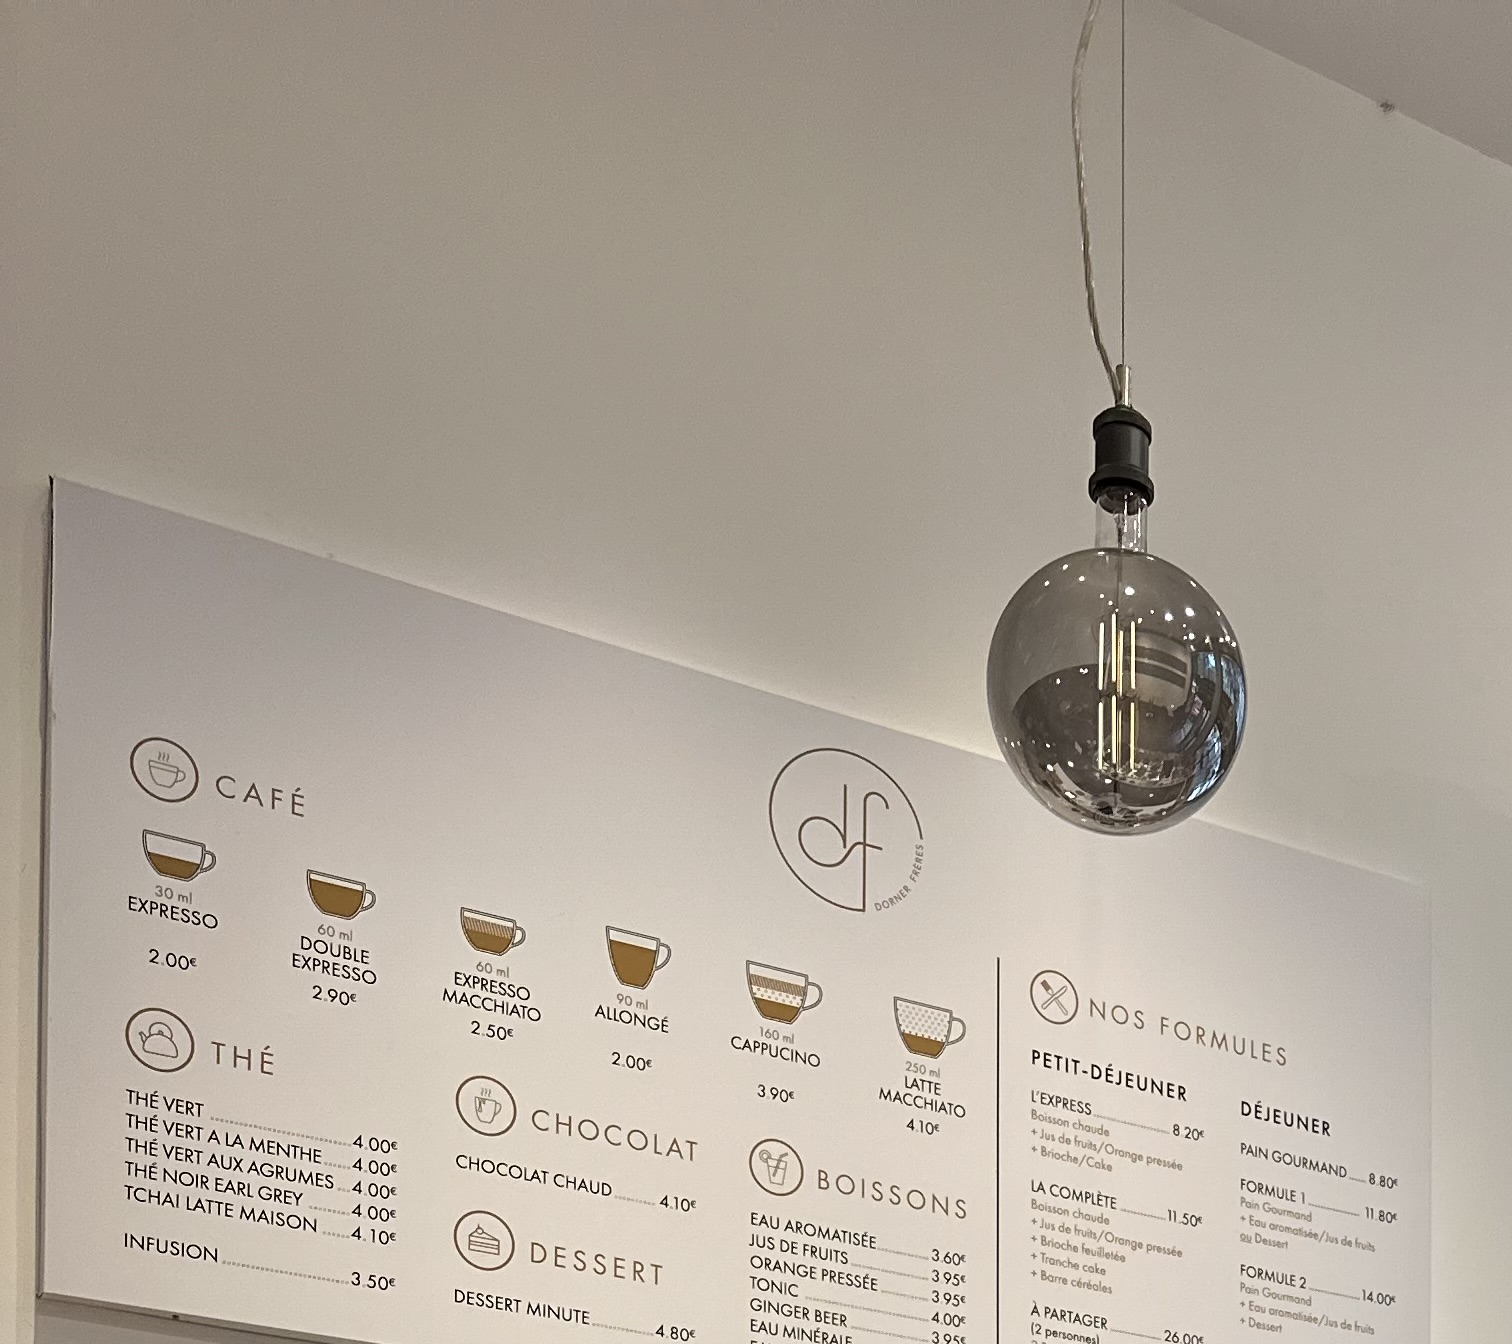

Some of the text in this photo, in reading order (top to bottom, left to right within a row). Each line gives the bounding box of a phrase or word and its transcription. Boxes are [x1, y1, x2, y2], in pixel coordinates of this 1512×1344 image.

[215, 775, 305, 817] CAFÉ
[154, 884, 193, 904] 30 ml
[874, 843, 925, 913] DORNER FRÈRES
[127, 896, 219, 930] EXPRESSO
[317, 922, 354, 942] 60 ml
[299, 935, 370, 966] DOUBLE
[291, 952, 378, 986] EXPRESSO
[475, 960, 510, 979] 60 ml
[453, 971, 531, 1001] EXPRESSO
[616, 993, 649, 1011] 90 ml
[442, 987, 542, 1022] MACCHIATO
[594, 1004, 670, 1034] ALLONGÉ
[758, 1026, 795, 1045] 160 ml
[1089, 998, 1288, 1067] NOS FORMULES
[211, 1041, 274, 1075] THÉ
[730, 1035, 821, 1068] CAPPUCINO
[905, 1060, 941, 1079] 250 ml
[1031, 1049, 1188, 1102] PETIT-DÉJEUNER
[904, 1075, 942, 1097] LATTE
[125, 1088, 159, 1110] THÉ
[163, 1096, 204, 1118] VERT
[878, 1087, 966, 1119] MACCHIATO
[1030, 1089, 1093, 1117] L'EXPRESS
[1240, 1100, 1331, 1137] DÉJEUNER
[125, 1112, 159, 1134] THÉ
[162, 1119, 204, 1142] VERT
[207, 1130, 221, 1146] A
[225, 1132, 245, 1150] LA
[249, 1137, 323, 1165] MENTHE
[531, 1109, 698, 1162] CHOCOLAT
[1030, 1108, 1110, 1138] Boisson chaude
[125, 1136, 159, 1158] THÉ
[162, 1143, 204, 1165] VERT
[207, 1152, 244, 1174] AUX
[247, 1161, 335, 1190] AGRUMES
[455, 1154, 550, 1185] CHOCOLAT
[553, 1173, 613, 1197] CHAUD
[1239, 1142, 1269, 1161] PAIN
[1271, 1150, 1348, 1179] GOURMAND
[124, 1160, 159, 1182] THÉ
[162, 1167, 210, 1191] NOIR
[214, 1179, 254, 1199] EARL
[258, 1186, 304, 1207] GREY
[817, 1169, 967, 1220] BOISSONS
[1030, 1179, 1046, 1195] LA
[1049, 1183, 1118, 1211] COMPLÈTE
[1239, 1178, 1297, 1203] FORMULE
[1299, 1191, 1306, 1205] 1
[124, 1184, 180, 1209] TCHAI
[186, 1196, 234, 1218] LATTE
[239, 1205, 318, 1233] MAISON
[750, 1212, 780, 1230] EAU
[784, 1219, 877, 1250] AROMATISÉE
[123, 1232, 218, 1263] INFUSION
[530, 1241, 664, 1286] DESSERT
[748, 1233, 776, 1251] JUS
[780, 1240, 799, 1256] DE
[802, 1243, 849, 1265] FRUITS
[749, 1255, 818, 1281] ORANGE
[820, 1268, 879, 1292] PRESSÉE
[749, 1275, 800, 1298] TONIC
[1239, 1263, 1297, 1288] FORMULE
[1299, 1276, 1307, 1290] 2
[454, 1288, 522, 1313] DESSERT
[526, 1301, 590, 1326] MINUTE
[749, 1297, 811, 1321] GINGER
[814, 1309, 848, 1329] BEER
[1030, 1300, 1041, 1318] À
[1043, 1305, 1109, 1331] PARTAGER
[749, 1318, 779, 1337] EAU
[1030, 1321, 1043, 1337] (2
